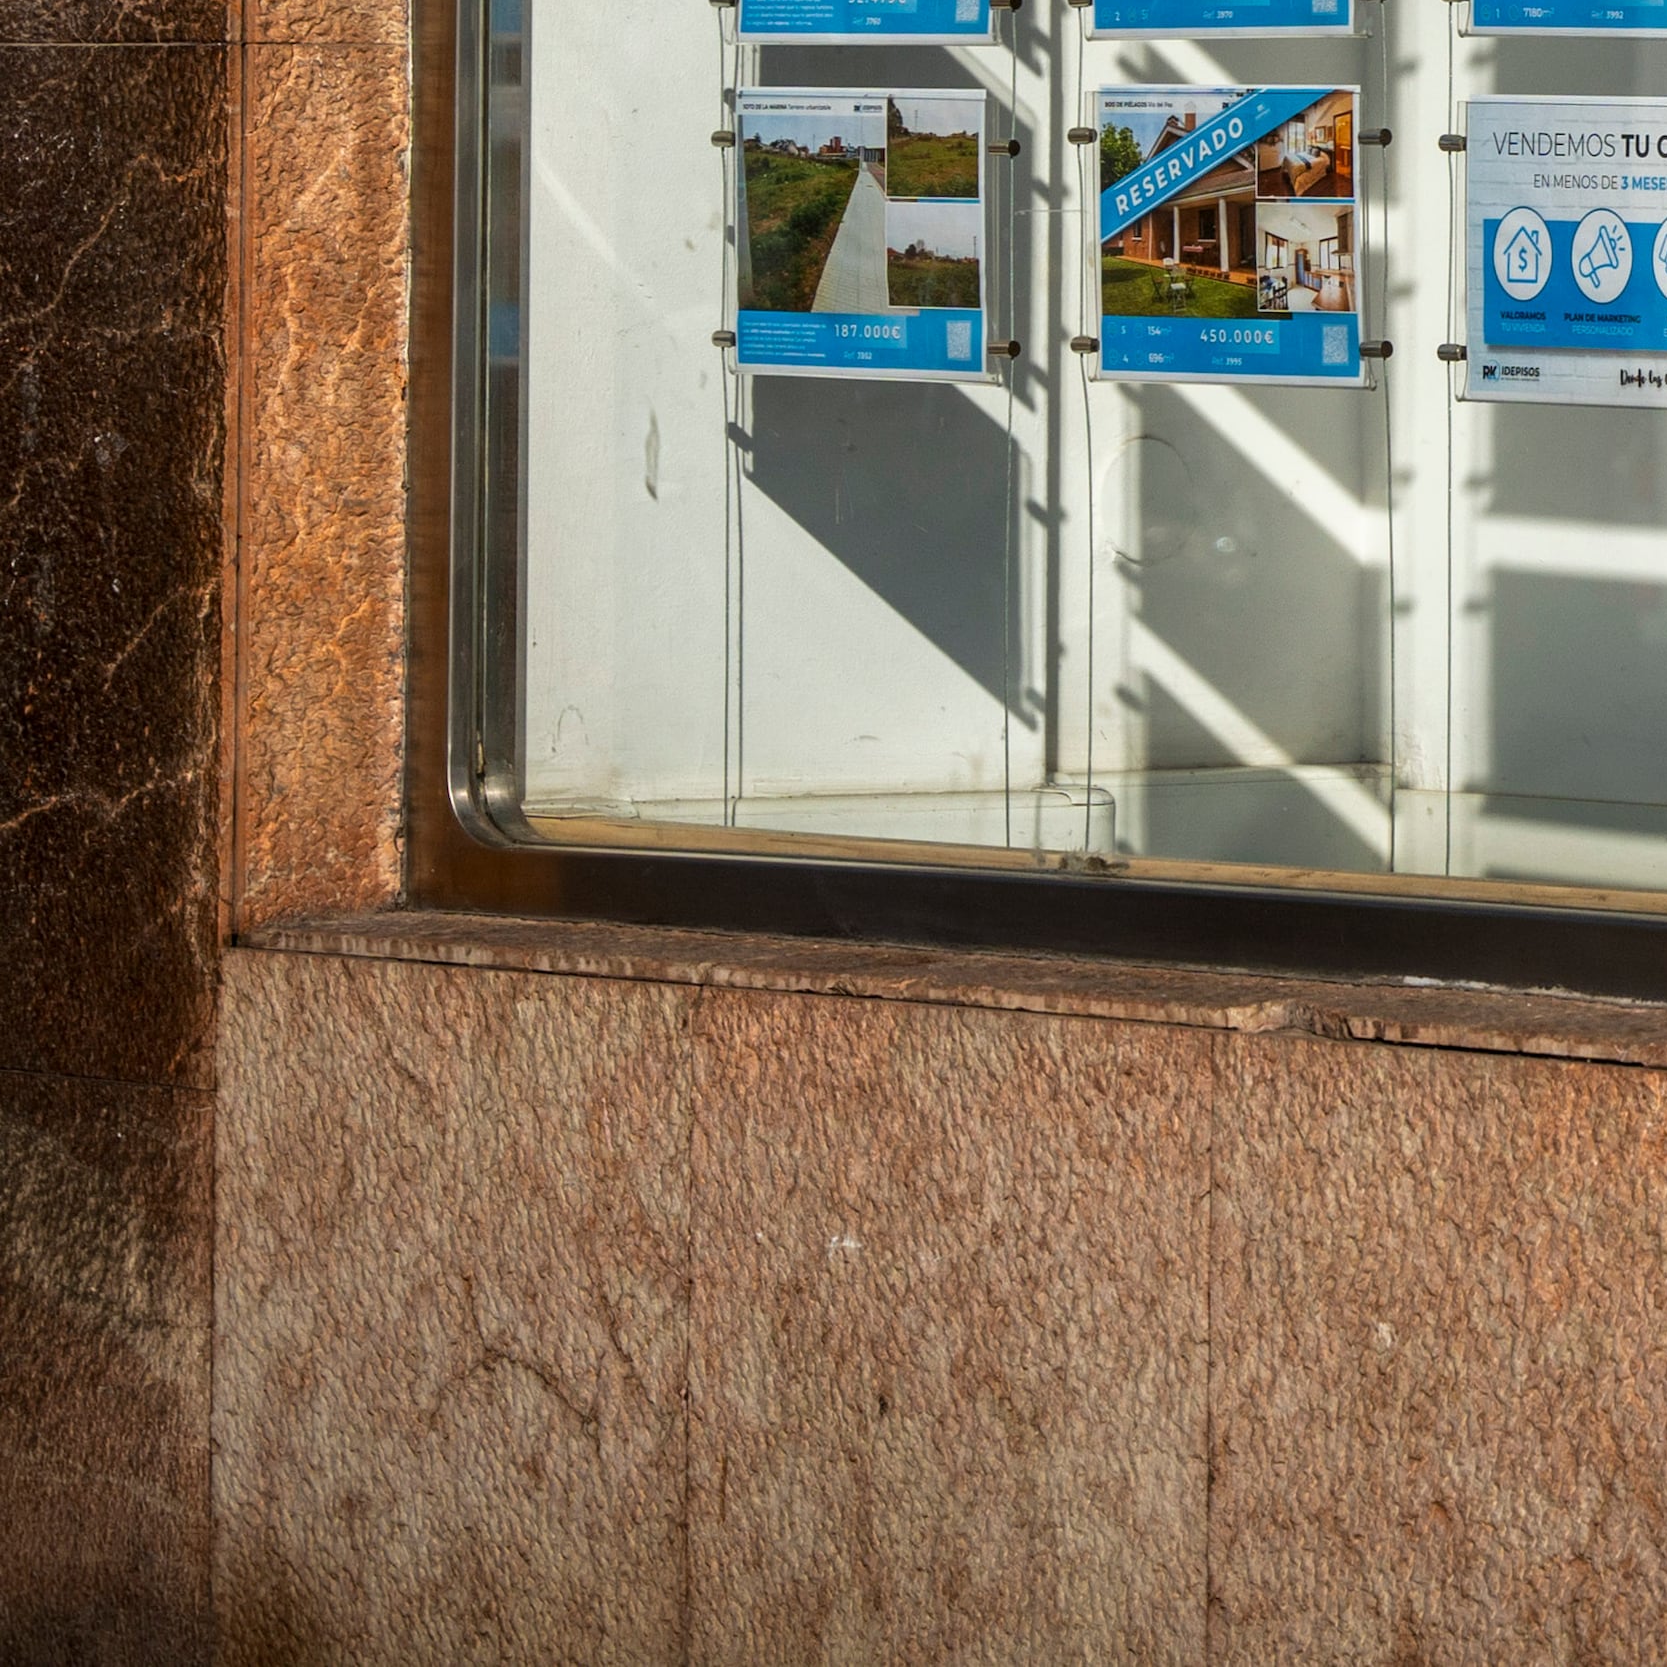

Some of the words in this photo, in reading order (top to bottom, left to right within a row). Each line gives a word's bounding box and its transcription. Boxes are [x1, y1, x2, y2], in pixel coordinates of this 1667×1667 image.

[1494, 132, 1615, 157] VENDEMOS
[1621, 134, 1649, 157] TU
[1115, 117, 1244, 216] RESERVADO
[1534, 174, 1550, 189] EN
[1553, 175, 1598, 189] MENOS
[1601, 175, 1617, 190] DE
[1621, 177, 1628, 190] 3
[1564, 313, 1583, 322] PLAN
[1585, 314, 1595, 322] DE
[1597, 314, 1641, 324] MARKETING
[834, 324, 901, 339] 187.000€
[1201, 328, 1274, 344] 450.000€
[1501, 366, 1540, 377] IDEPISOS
